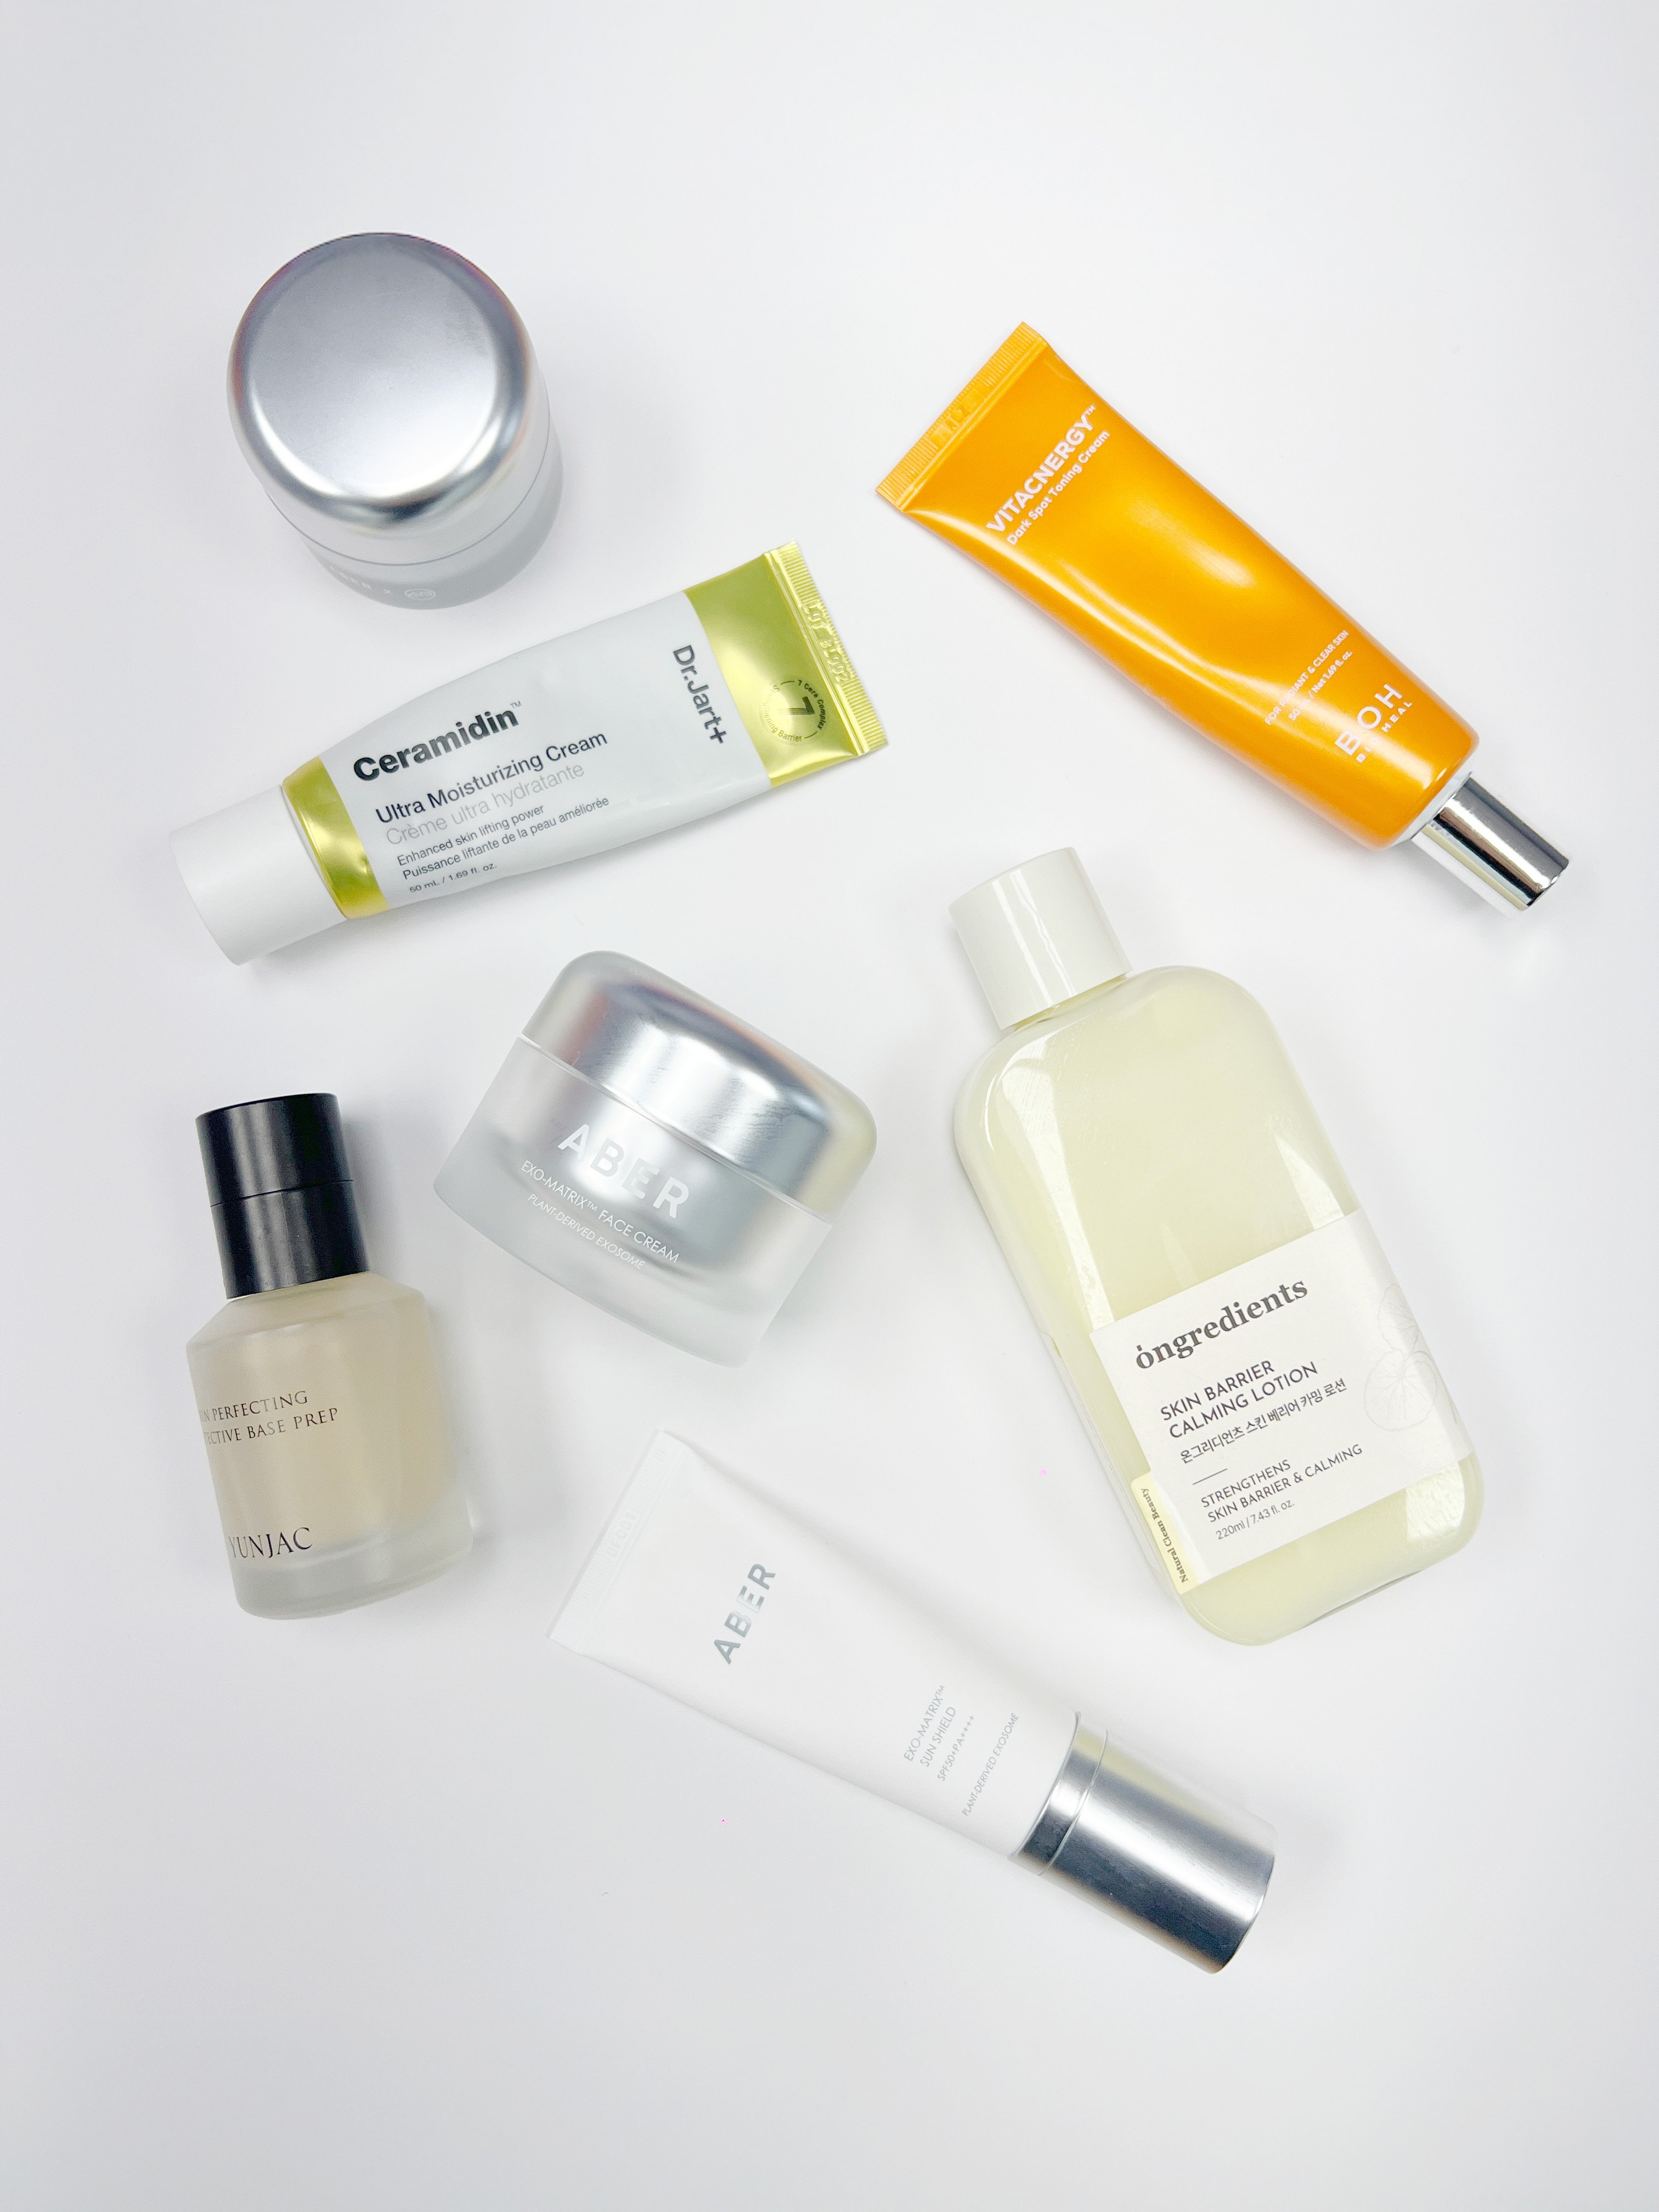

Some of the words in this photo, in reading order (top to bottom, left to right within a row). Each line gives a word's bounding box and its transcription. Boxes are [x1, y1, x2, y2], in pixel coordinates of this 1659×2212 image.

[1007, 519, 1032, 545] Dark
[1028, 496, 1052, 520] Spot
[1048, 463, 1082, 496] Toning
[1078, 430, 1110, 464] Cream
[673, 645, 727, 744] Dr.Jart+
[1265, 706, 1282, 725] FOR
[1307, 665, 1316, 674] &
[1313, 644, 1336, 667] CLEAR
[1333, 630, 1350, 646] SKIN
[1311, 678, 1327, 693] Net
[777, 730, 802, 742] Barrier
[817, 699, 826, 730] Complex
[1334, 684, 1403, 756] BOH
[376, 801, 425, 823] Ultra
[427, 754, 544, 808] Moisturizing
[546, 733, 607, 761] Cream
[386, 817, 448, 844] Crème
[452, 801, 491, 825] ultra
[492, 762, 585, 808] hydratante
[397, 839, 454, 866] Enhanced
[455, 832, 478, 845] skin
[478, 819, 510, 837] lifting
[511, 805, 544, 826] power
[403, 855, 461, 879] Puissance
[462, 840, 500, 859] liftante
[502, 833, 516, 844] de
[517, 828, 528, 838] la
[530, 817, 557, 836] peau
[558, 798, 609, 823] améliorée
[410, 884, 422, 893] 50
[425, 880, 440, 888] mL
[448, 870, 468, 881] 1.69
[483, 863, 497, 871] oz.
[557, 1124, 690, 1218] ABER
[528, 1193, 596, 1240] PLANT-DERIVED
[596, 1236, 646, 1269] EXOSOME
[598, 1209, 634, 1237] FACE
[634, 1231, 680, 1263] CREAM
[212, 1390, 308, 1421] PERFECTING
[1160, 1392, 1201, 1421] SKIN
[1204, 1359, 1275, 1401] BARRIER
[1169, 1393, 1249, 1438] CALMING
[1252, 1361, 1318, 1402] LOTION
[247, 1419, 286, 1439] BASE
[293, 1407, 338, 1429] PREP
[1181, 1426, 1245, 1464] 온그리디언츠
[1246, 1414, 1268, 1434] 스킨
[1267, 1399, 1301, 1422] 베리어
[1300, 1389, 1323, 1407] 카밍
[1324, 1378, 1347, 1397] 로션
[1141, 1488, 1160, 1520] Beauty
[1201, 1459, 1291, 1508] STRENGTHENS
[1208, 1502, 1238, 1522] SKIN
[1239, 1477, 1291, 1508] BARRIER
[1293, 1472, 1304, 1483] &
[1305, 1443, 1363, 1477] CALMING
[228, 1527, 313, 1558] YUNJAC
[1158, 1520, 1172, 1547] Clean
[1216, 1520, 1245, 1539] 220ml
[1246, 1517, 1250, 1528] /
[1250, 1509, 1271, 1524] 7.43
[1271, 1505, 1280, 1514] fl.
[1280, 1499, 1295, 1510] oz.
[1167, 1548, 1189, 1583] Natural
[714, 1564, 776, 1665] ABER
[920, 1743, 937, 1767] SUN
[933, 1707, 956, 1744] SHIELD
[962, 1756, 996, 1816] PLANT-DERIVED
[993, 1712, 1019, 1757] EXOSOME
